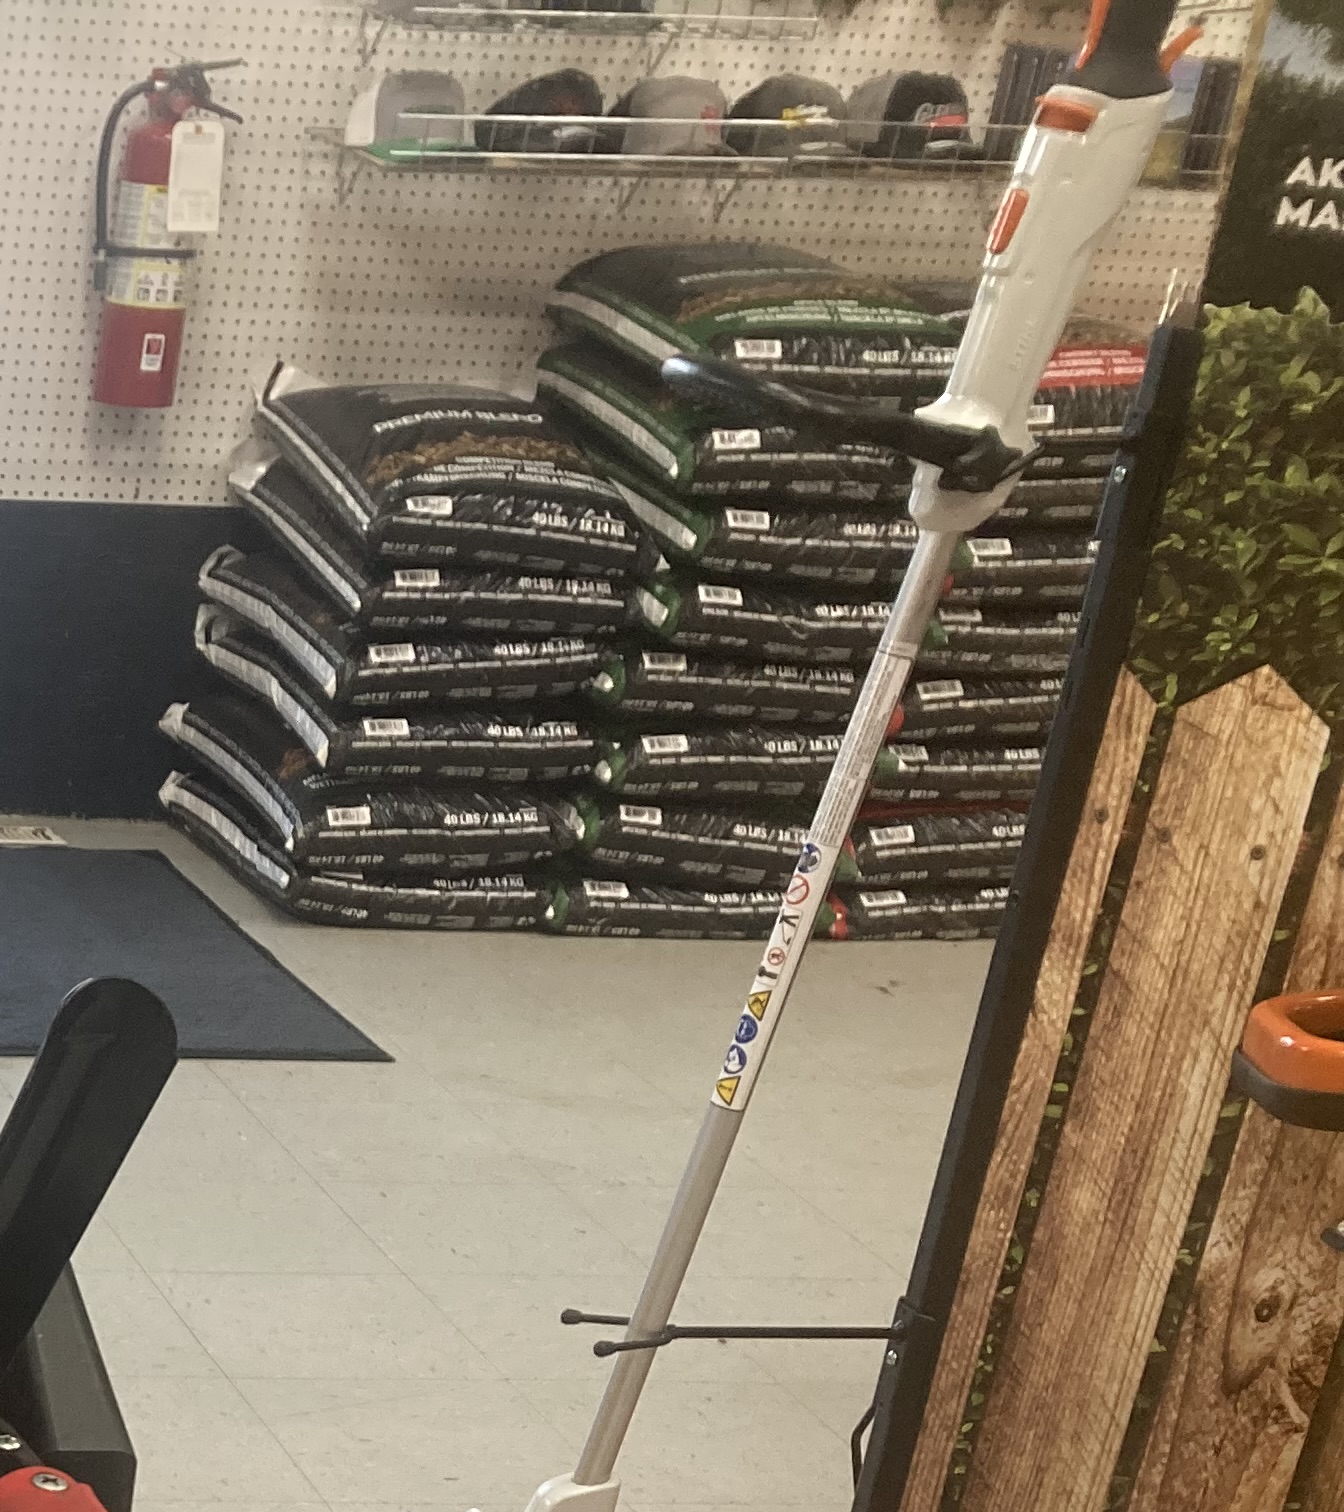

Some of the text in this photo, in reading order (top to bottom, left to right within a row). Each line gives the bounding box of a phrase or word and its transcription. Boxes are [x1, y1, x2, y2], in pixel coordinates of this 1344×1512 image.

[1275, 195, 1344, 230] MA
[443, 813, 458, 826] 40
[459, 812, 481, 826] LBS
[492, 811, 522, 825] 18.14
